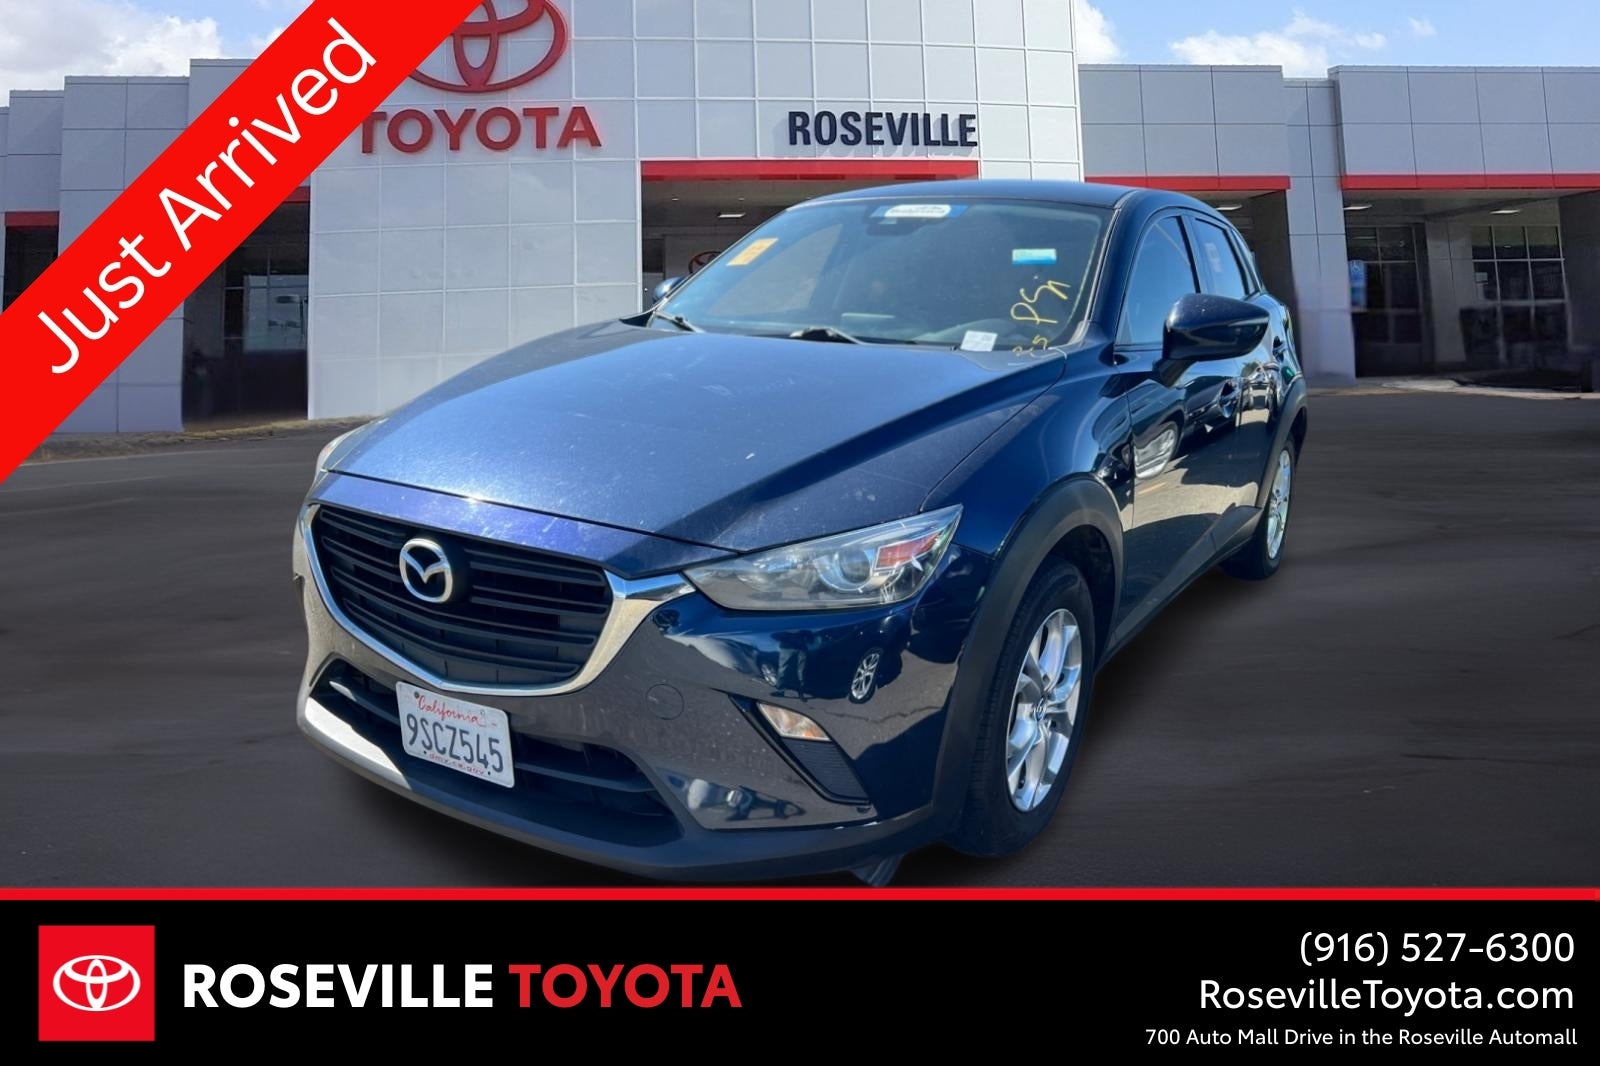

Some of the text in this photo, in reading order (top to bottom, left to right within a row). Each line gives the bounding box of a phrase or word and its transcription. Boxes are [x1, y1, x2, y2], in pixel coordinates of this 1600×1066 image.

[360, 106, 602, 154] TOYOTA
[788, 111, 978, 147] ROSEVILLE
[417, 694, 487, 728] California
[406, 713, 504, 773] 9SCZ545
